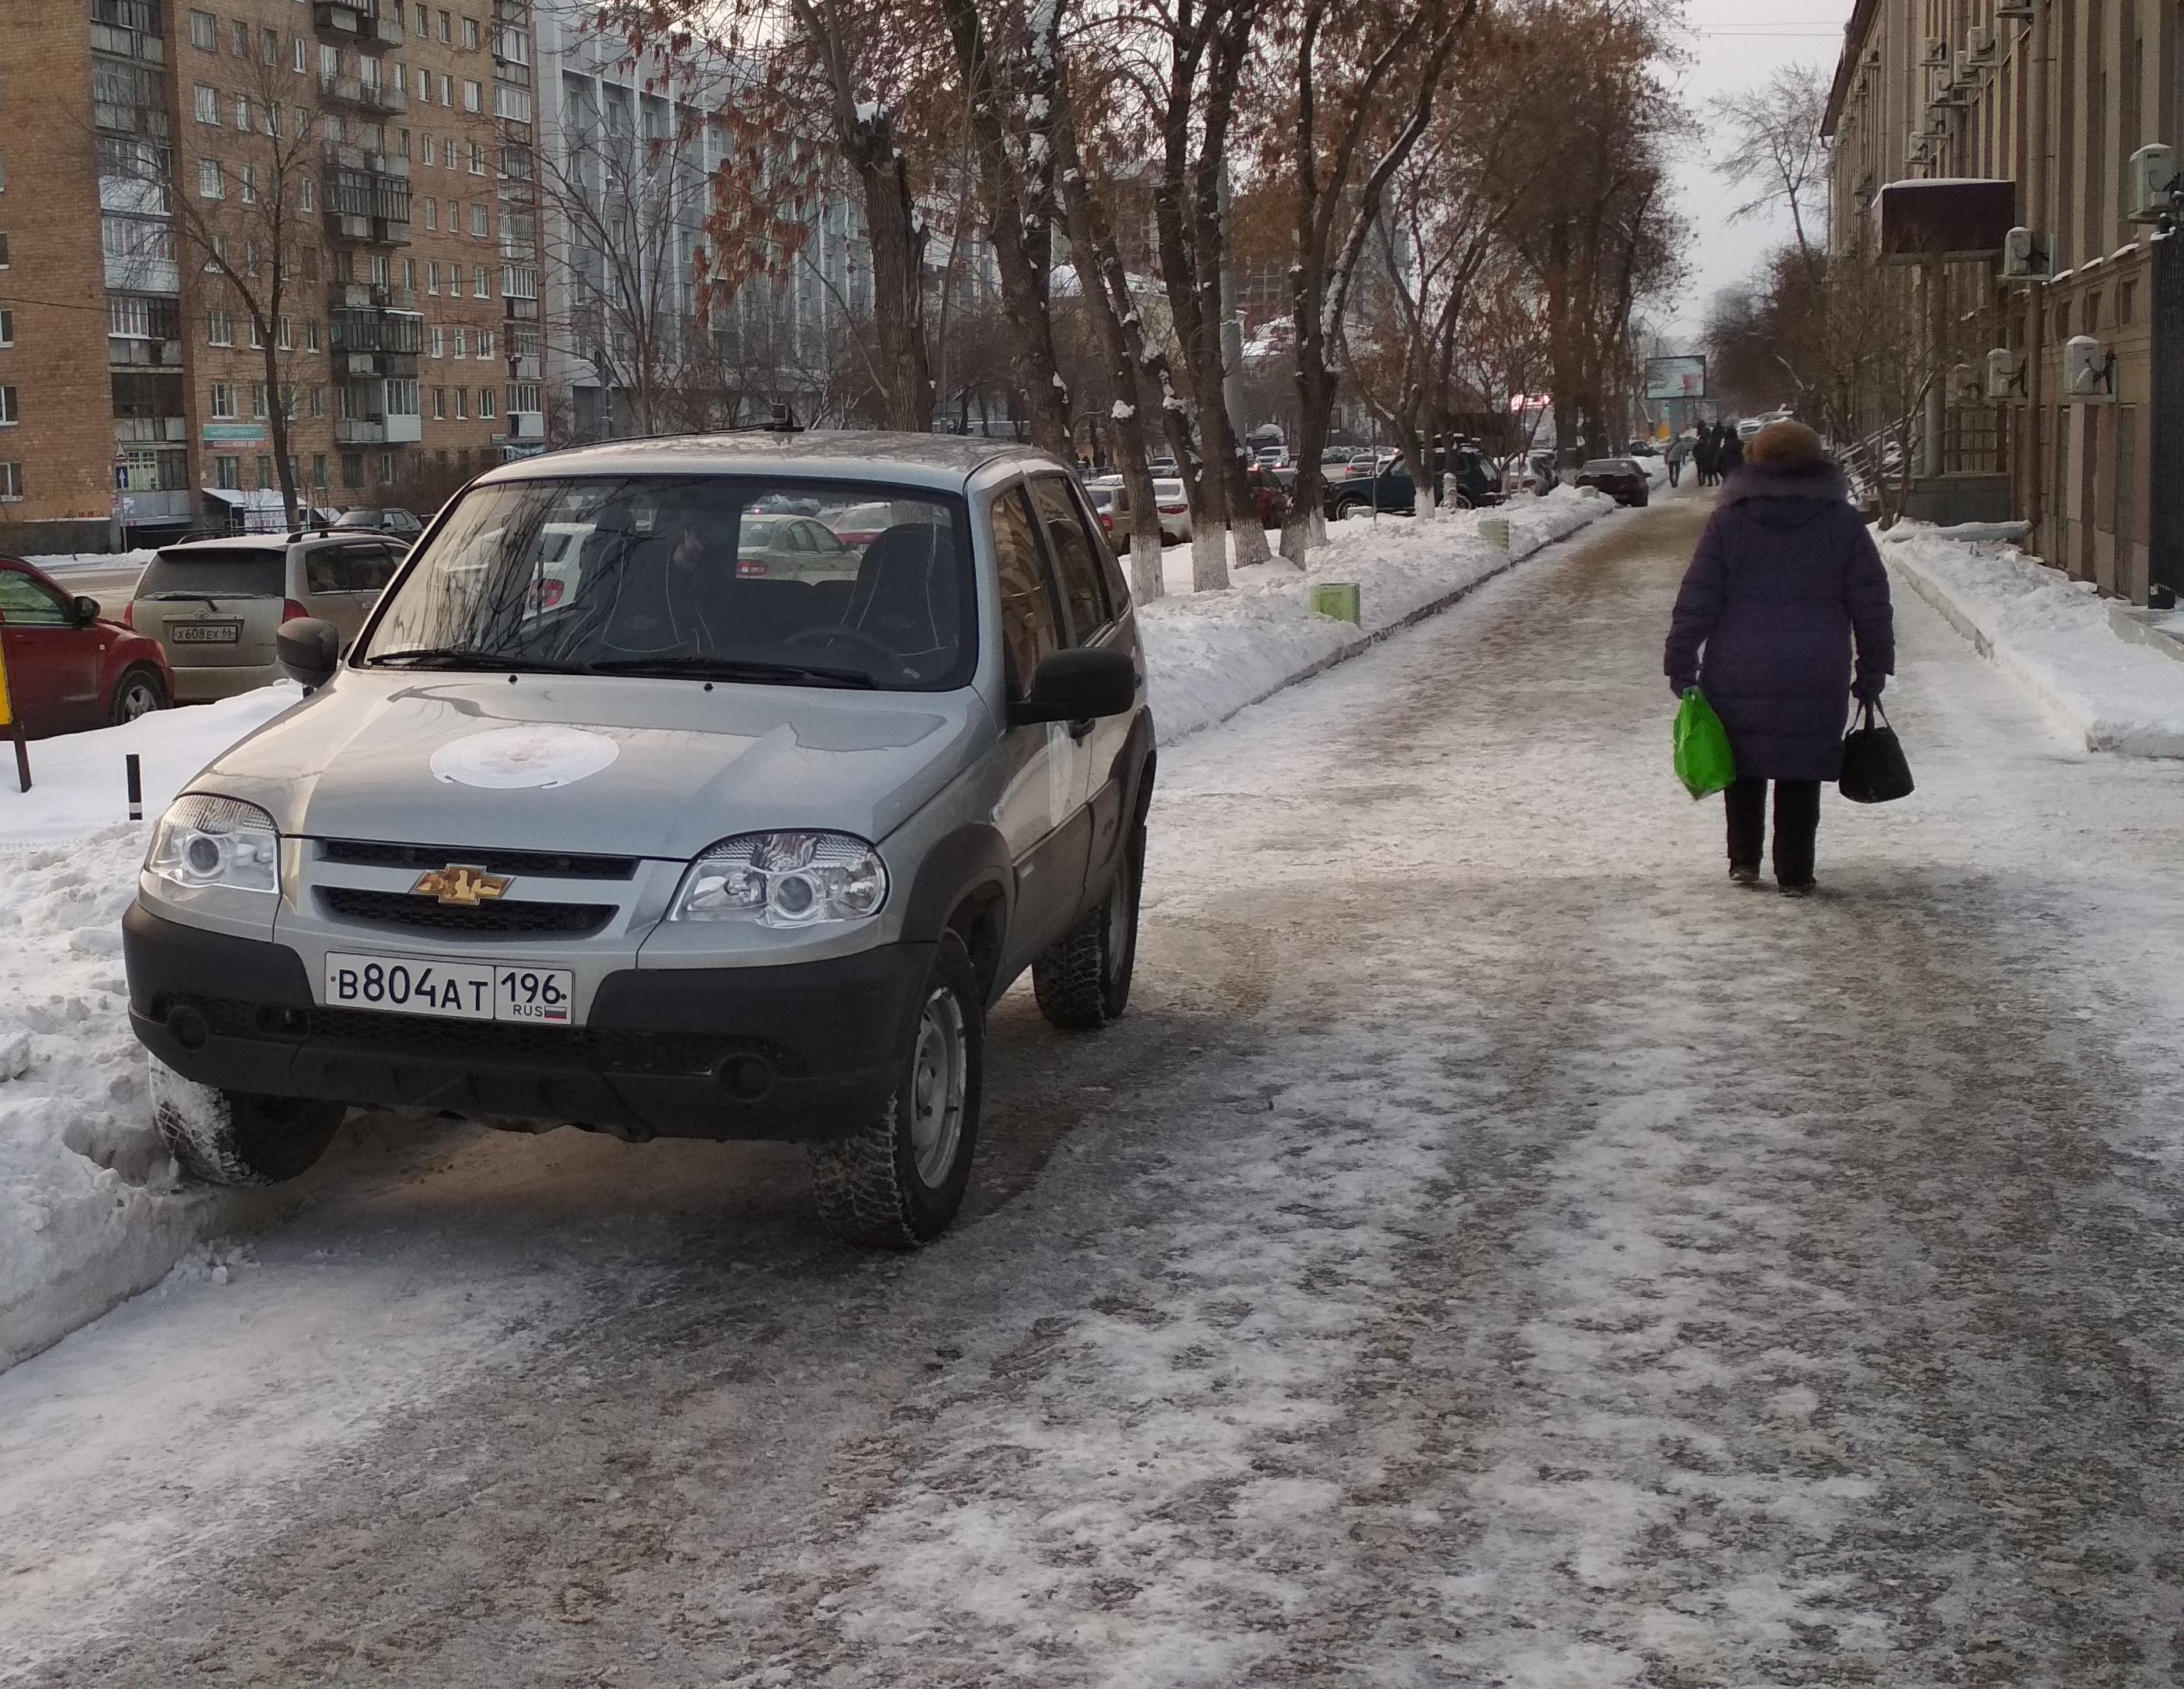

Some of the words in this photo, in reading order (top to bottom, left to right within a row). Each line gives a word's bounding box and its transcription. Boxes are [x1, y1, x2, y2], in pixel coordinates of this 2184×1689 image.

[340, 963, 488, 1011] В804АТ
[501, 972, 561, 1004] 196
[513, 1004, 543, 1017] RUS
